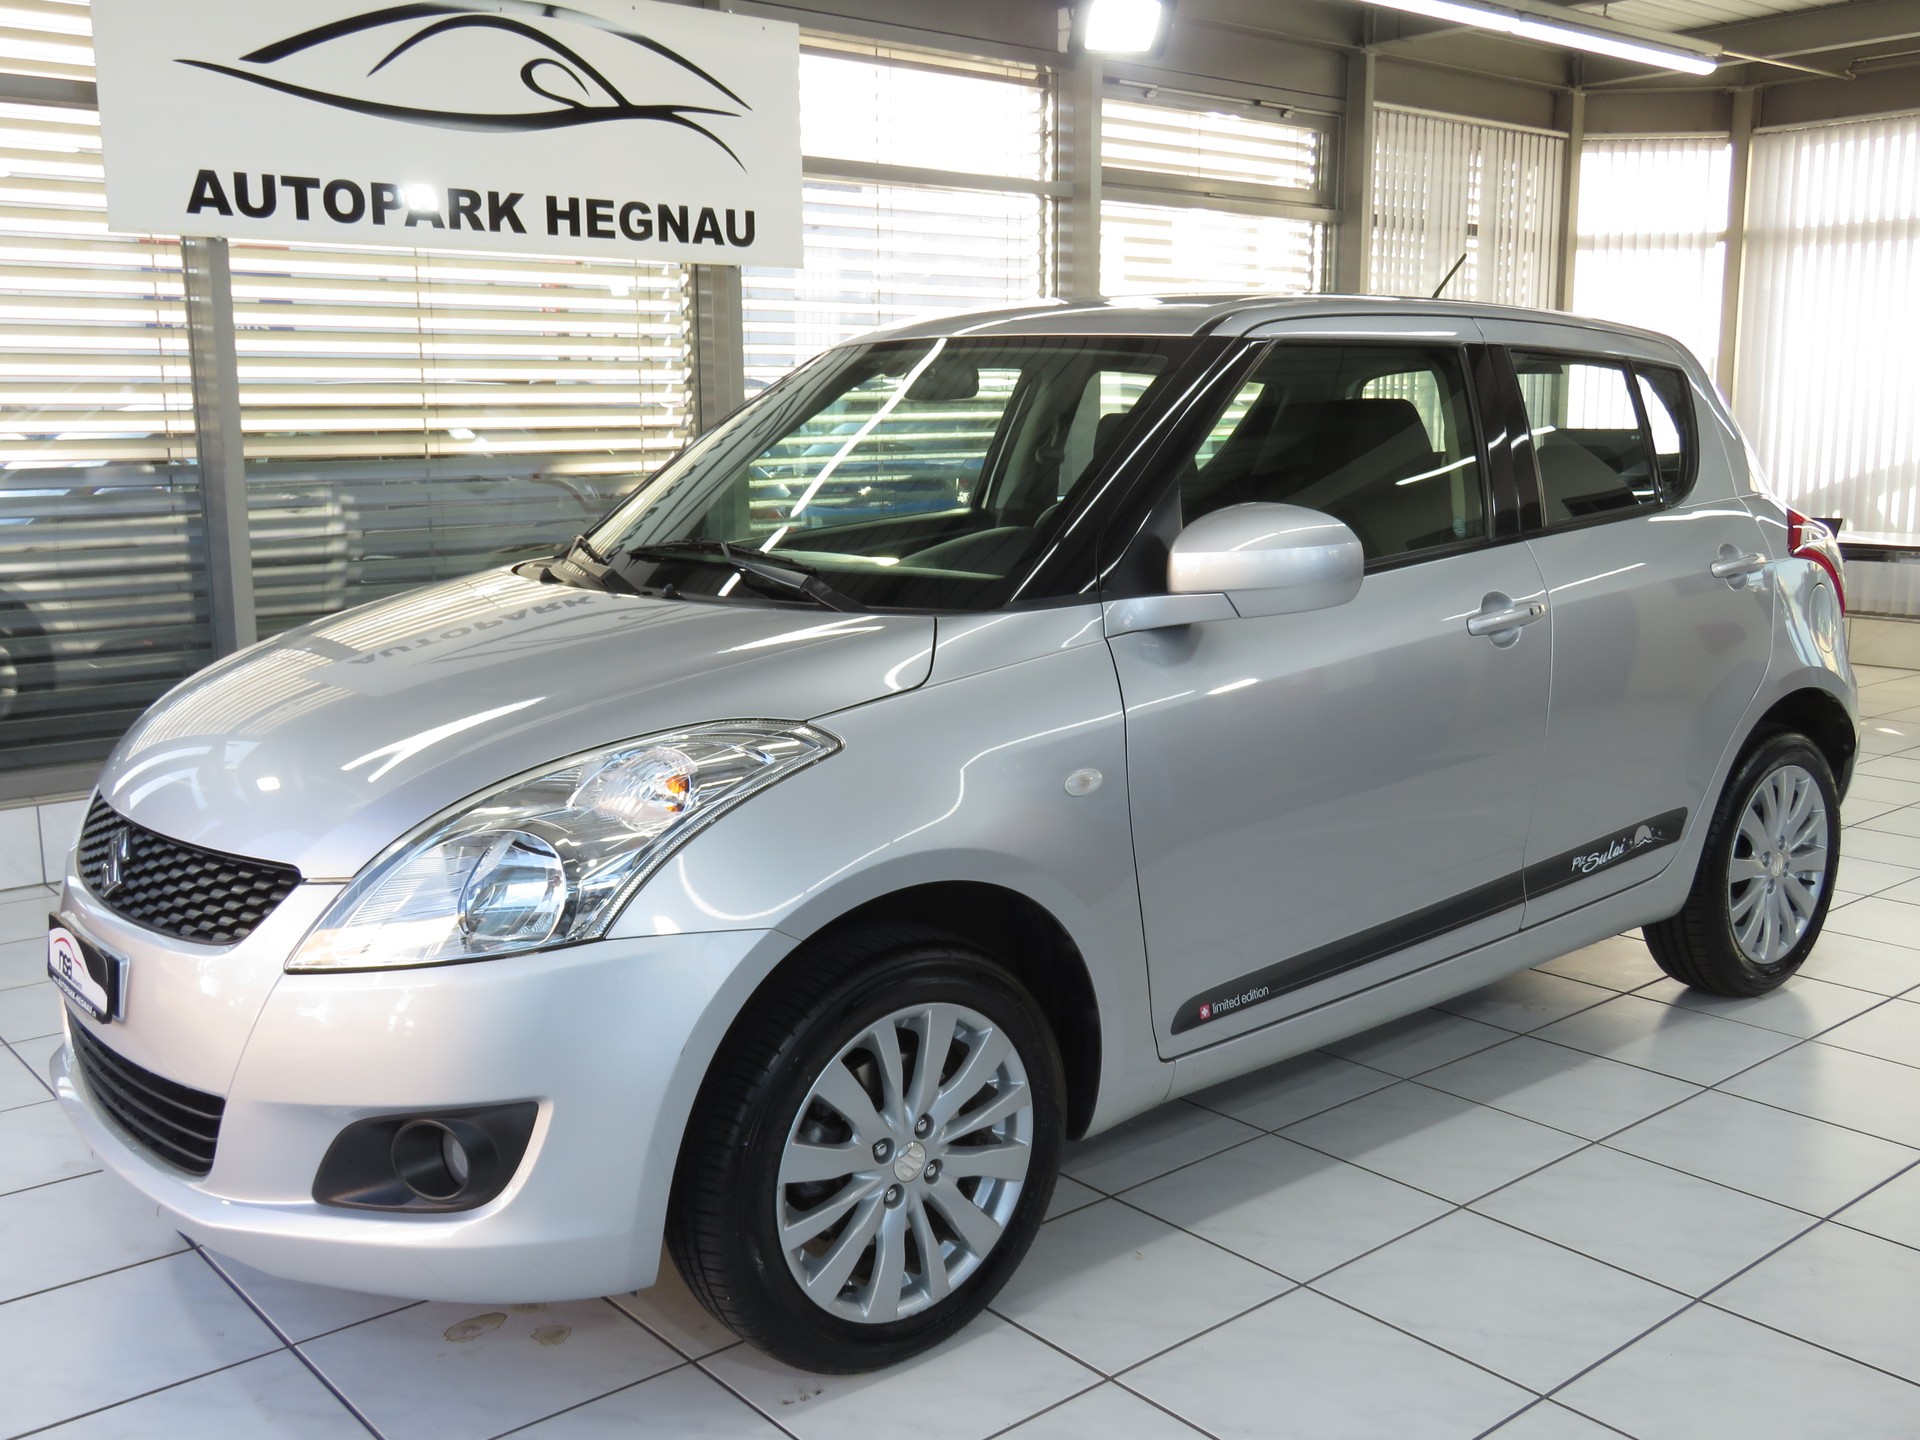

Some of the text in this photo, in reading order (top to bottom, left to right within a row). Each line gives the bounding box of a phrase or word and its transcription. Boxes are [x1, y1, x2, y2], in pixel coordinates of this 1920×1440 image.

[546, 196, 755, 248] HEGNAU
[1582, 837, 1627, 873] Sulai
[1212, 986, 1269, 1014] limited edition
